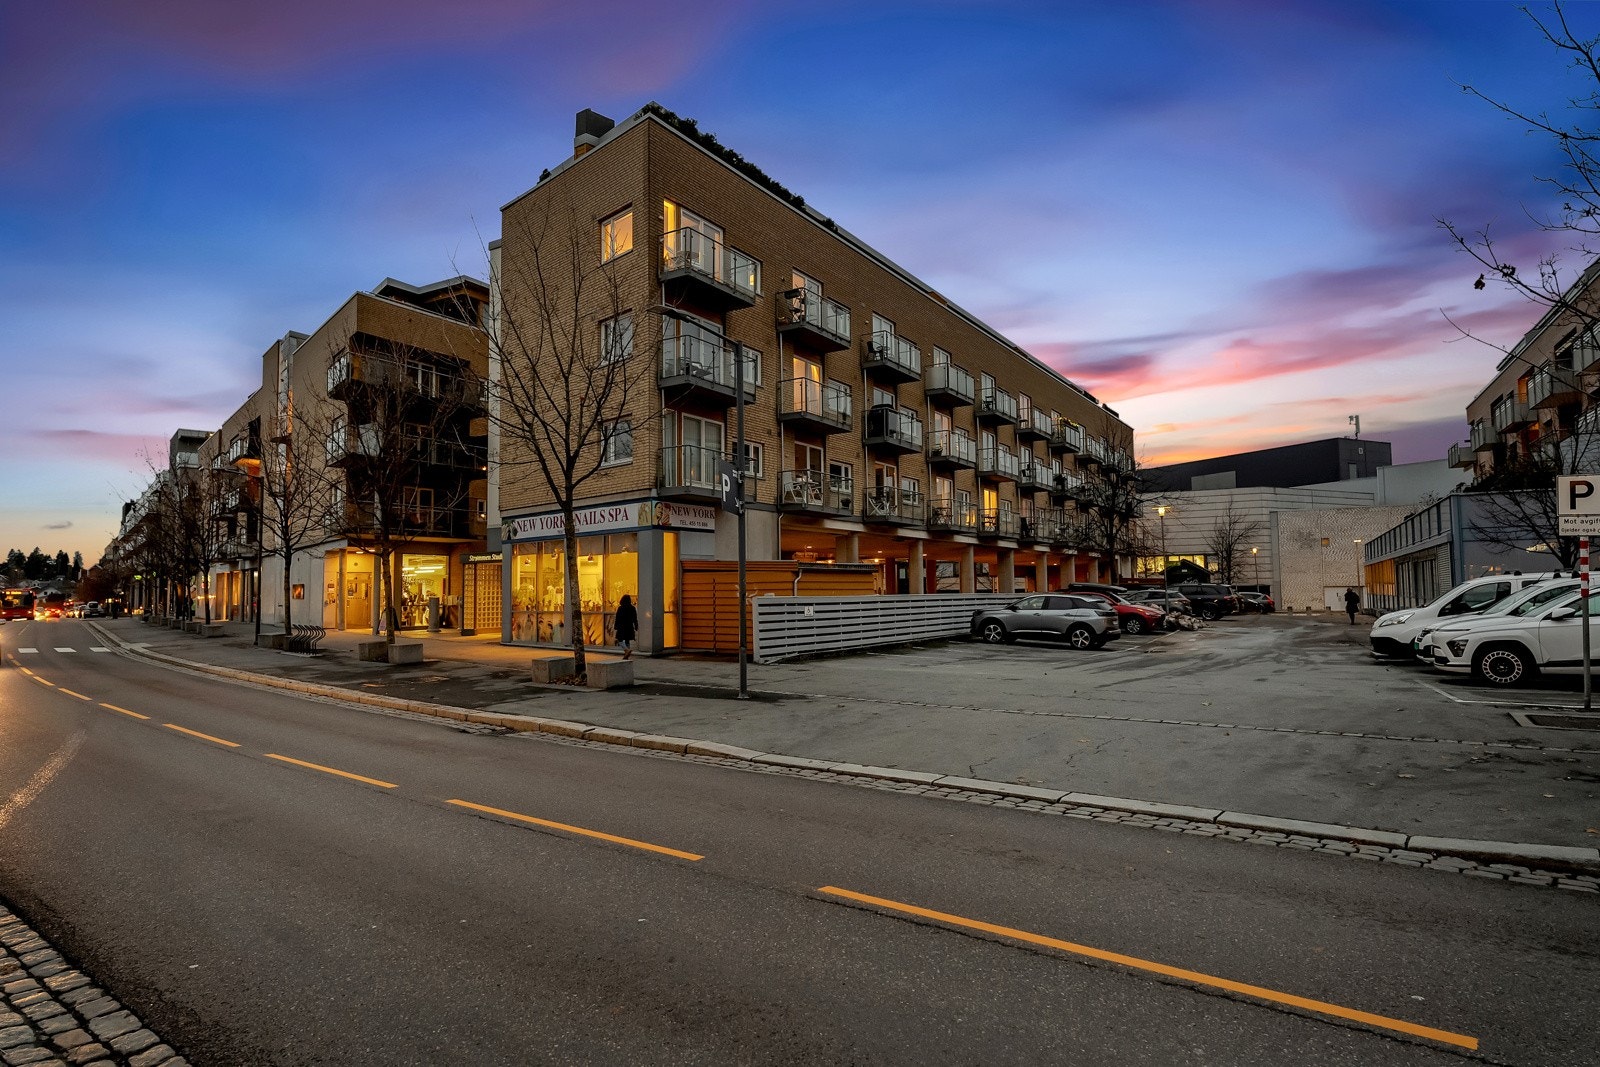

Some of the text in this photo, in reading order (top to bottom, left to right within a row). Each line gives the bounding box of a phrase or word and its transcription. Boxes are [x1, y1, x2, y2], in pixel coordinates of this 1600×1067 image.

[722, 473, 731, 502] P
[1569, 480, 1595, 510] P
[516, 507, 629, 533] NEW YORK NAILS SPA
[671, 505, 715, 519] NEW YORK
